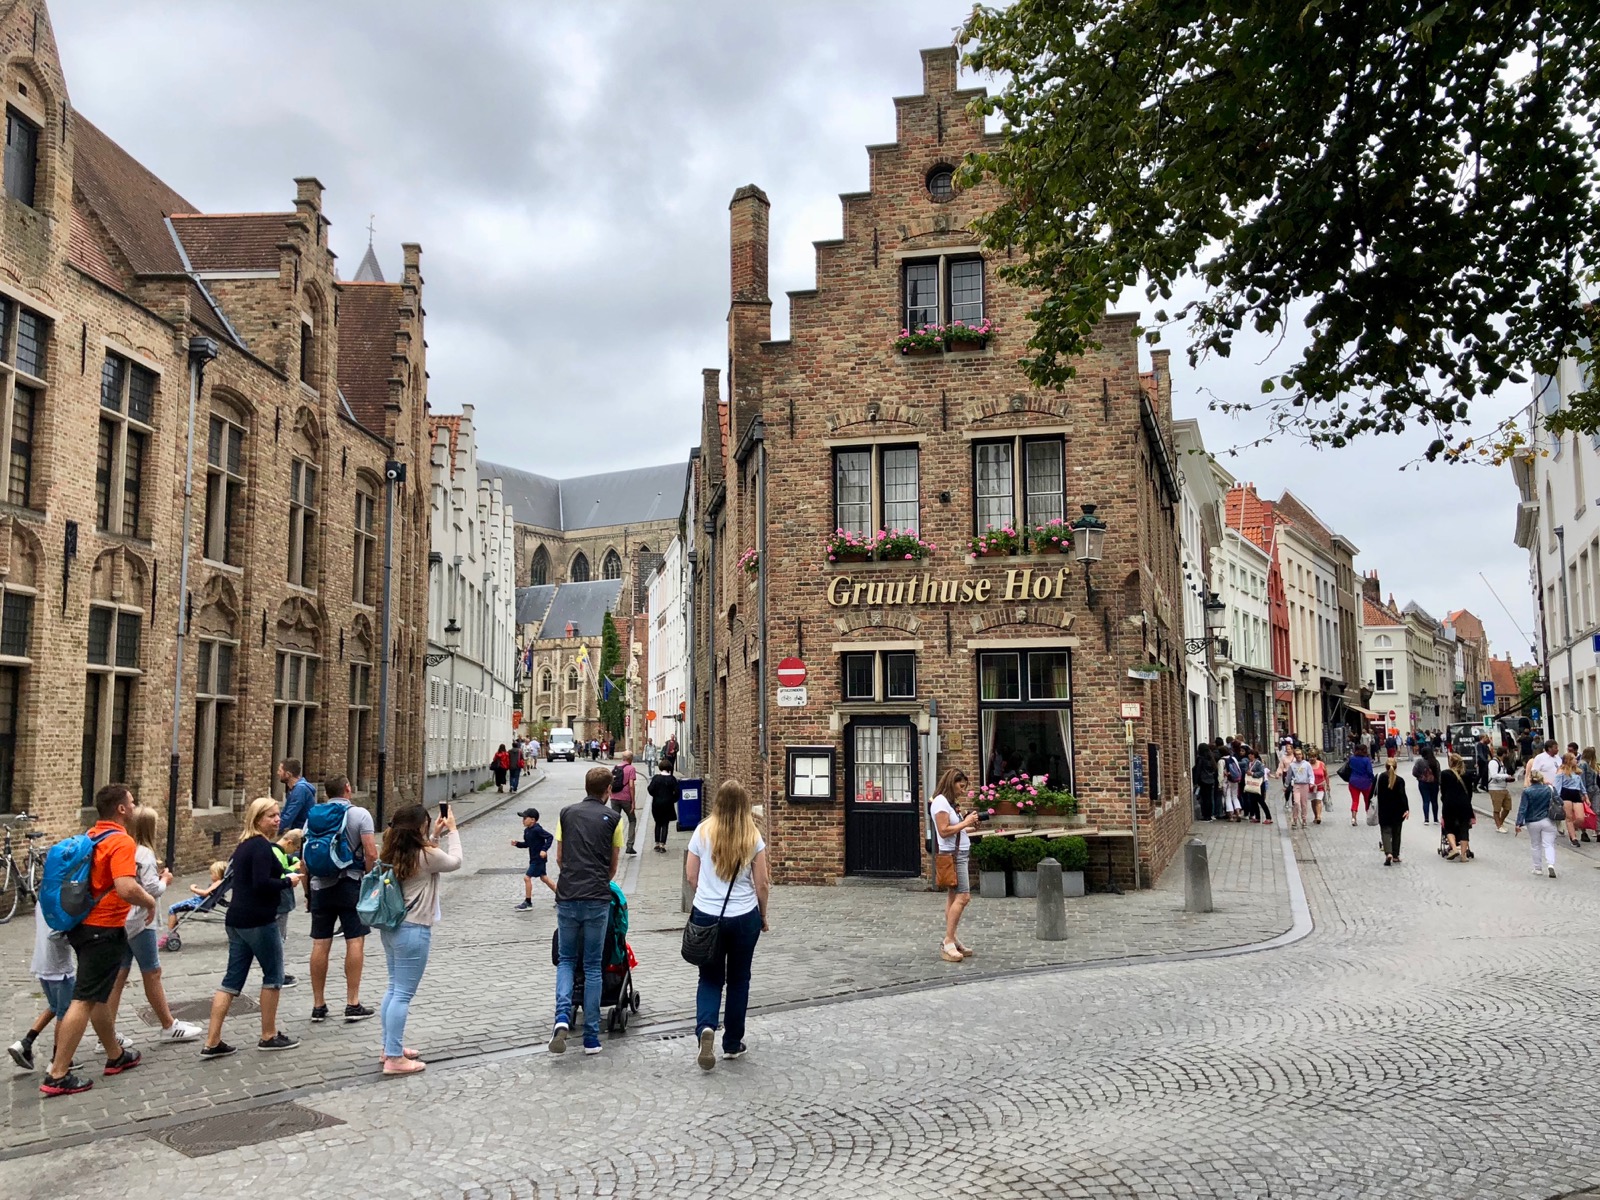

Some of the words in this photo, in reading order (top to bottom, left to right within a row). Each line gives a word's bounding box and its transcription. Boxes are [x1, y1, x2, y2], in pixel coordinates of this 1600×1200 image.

[827, 572, 992, 606] Gruuthuse
[1002, 567, 1069, 601] Hof
[1482, 684, 1492, 697] P
[1531, 708, 1537, 716] P
